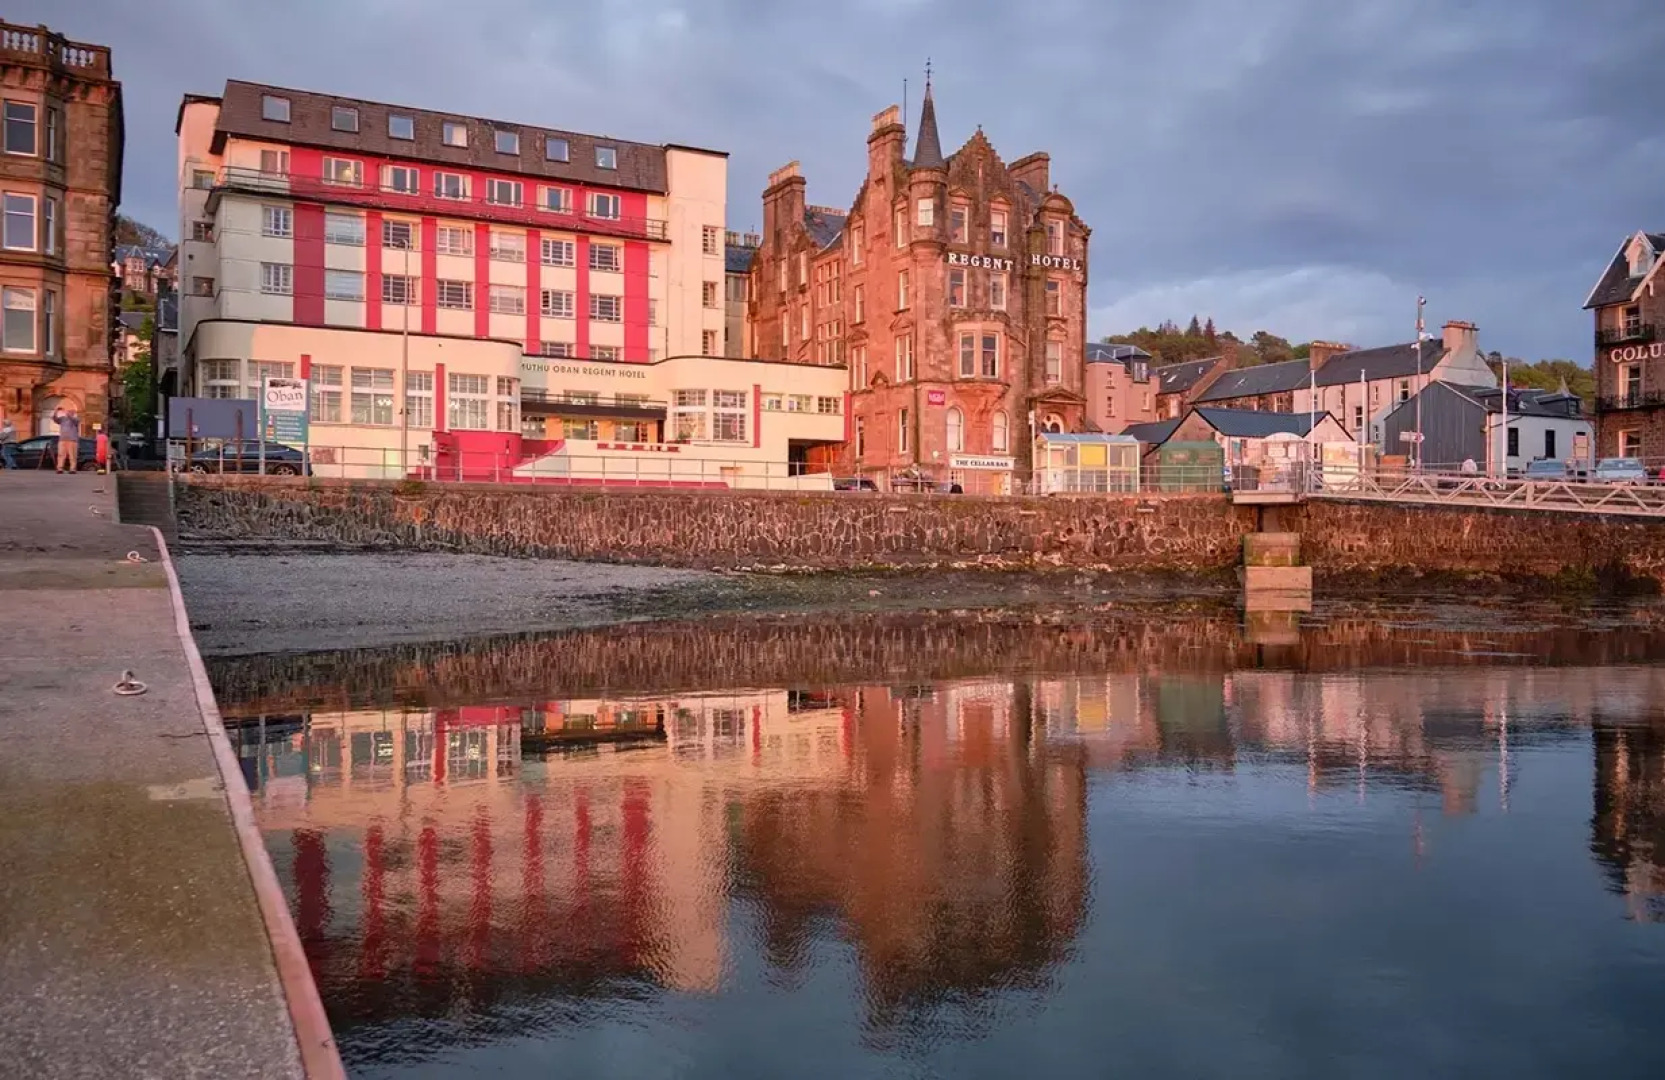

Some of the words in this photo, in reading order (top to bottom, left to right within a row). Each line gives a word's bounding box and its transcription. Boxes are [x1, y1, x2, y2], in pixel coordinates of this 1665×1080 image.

[948, 252, 1013, 271] REGENT
[1031, 254, 1081, 271] HOTEL
[1610, 342, 1665, 363] COLU
[553, 365, 579, 375] OBAN
[582, 367, 616, 377] REGENT
[619, 369, 646, 378] HOTEL
[267, 390, 303, 402] Oban
[955, 459, 969, 467] THE
[970, 459, 995, 468] CELLAR
